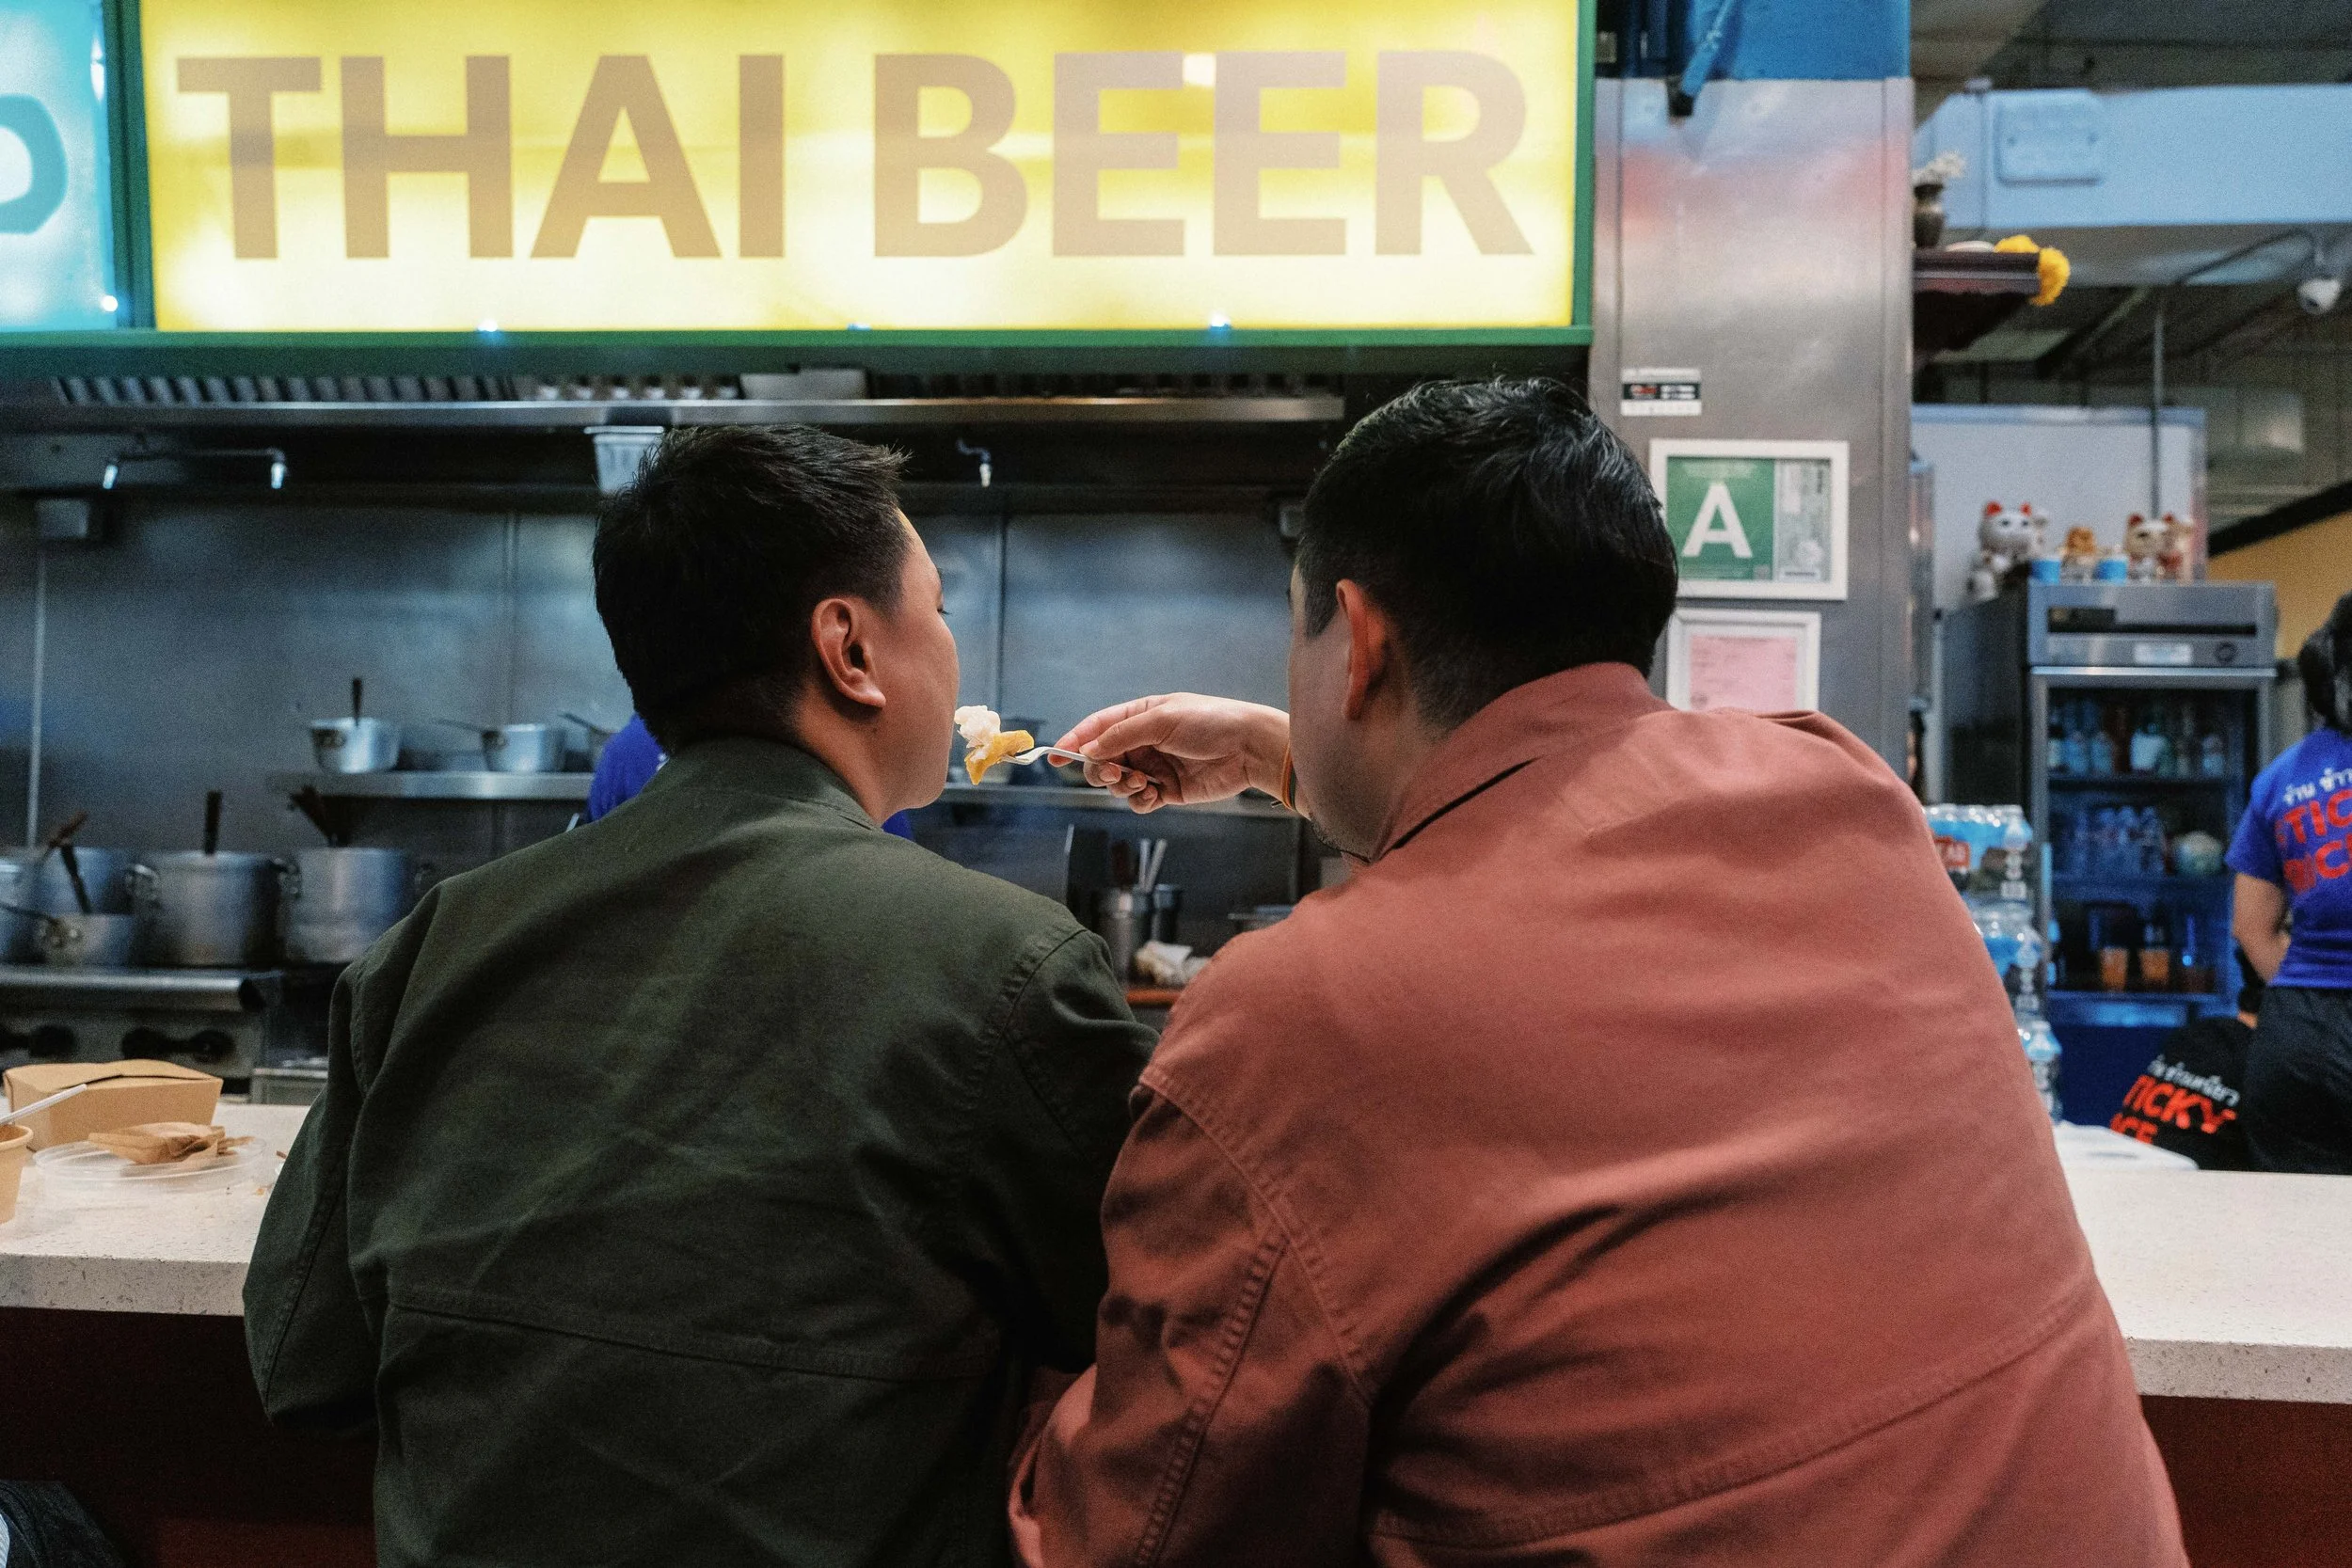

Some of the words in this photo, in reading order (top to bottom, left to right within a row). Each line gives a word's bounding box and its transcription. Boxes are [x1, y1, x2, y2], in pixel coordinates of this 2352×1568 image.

[177, 54, 785, 259] THAI
[873, 50, 1535, 258] BEER
[1680, 482, 1753, 558] A
